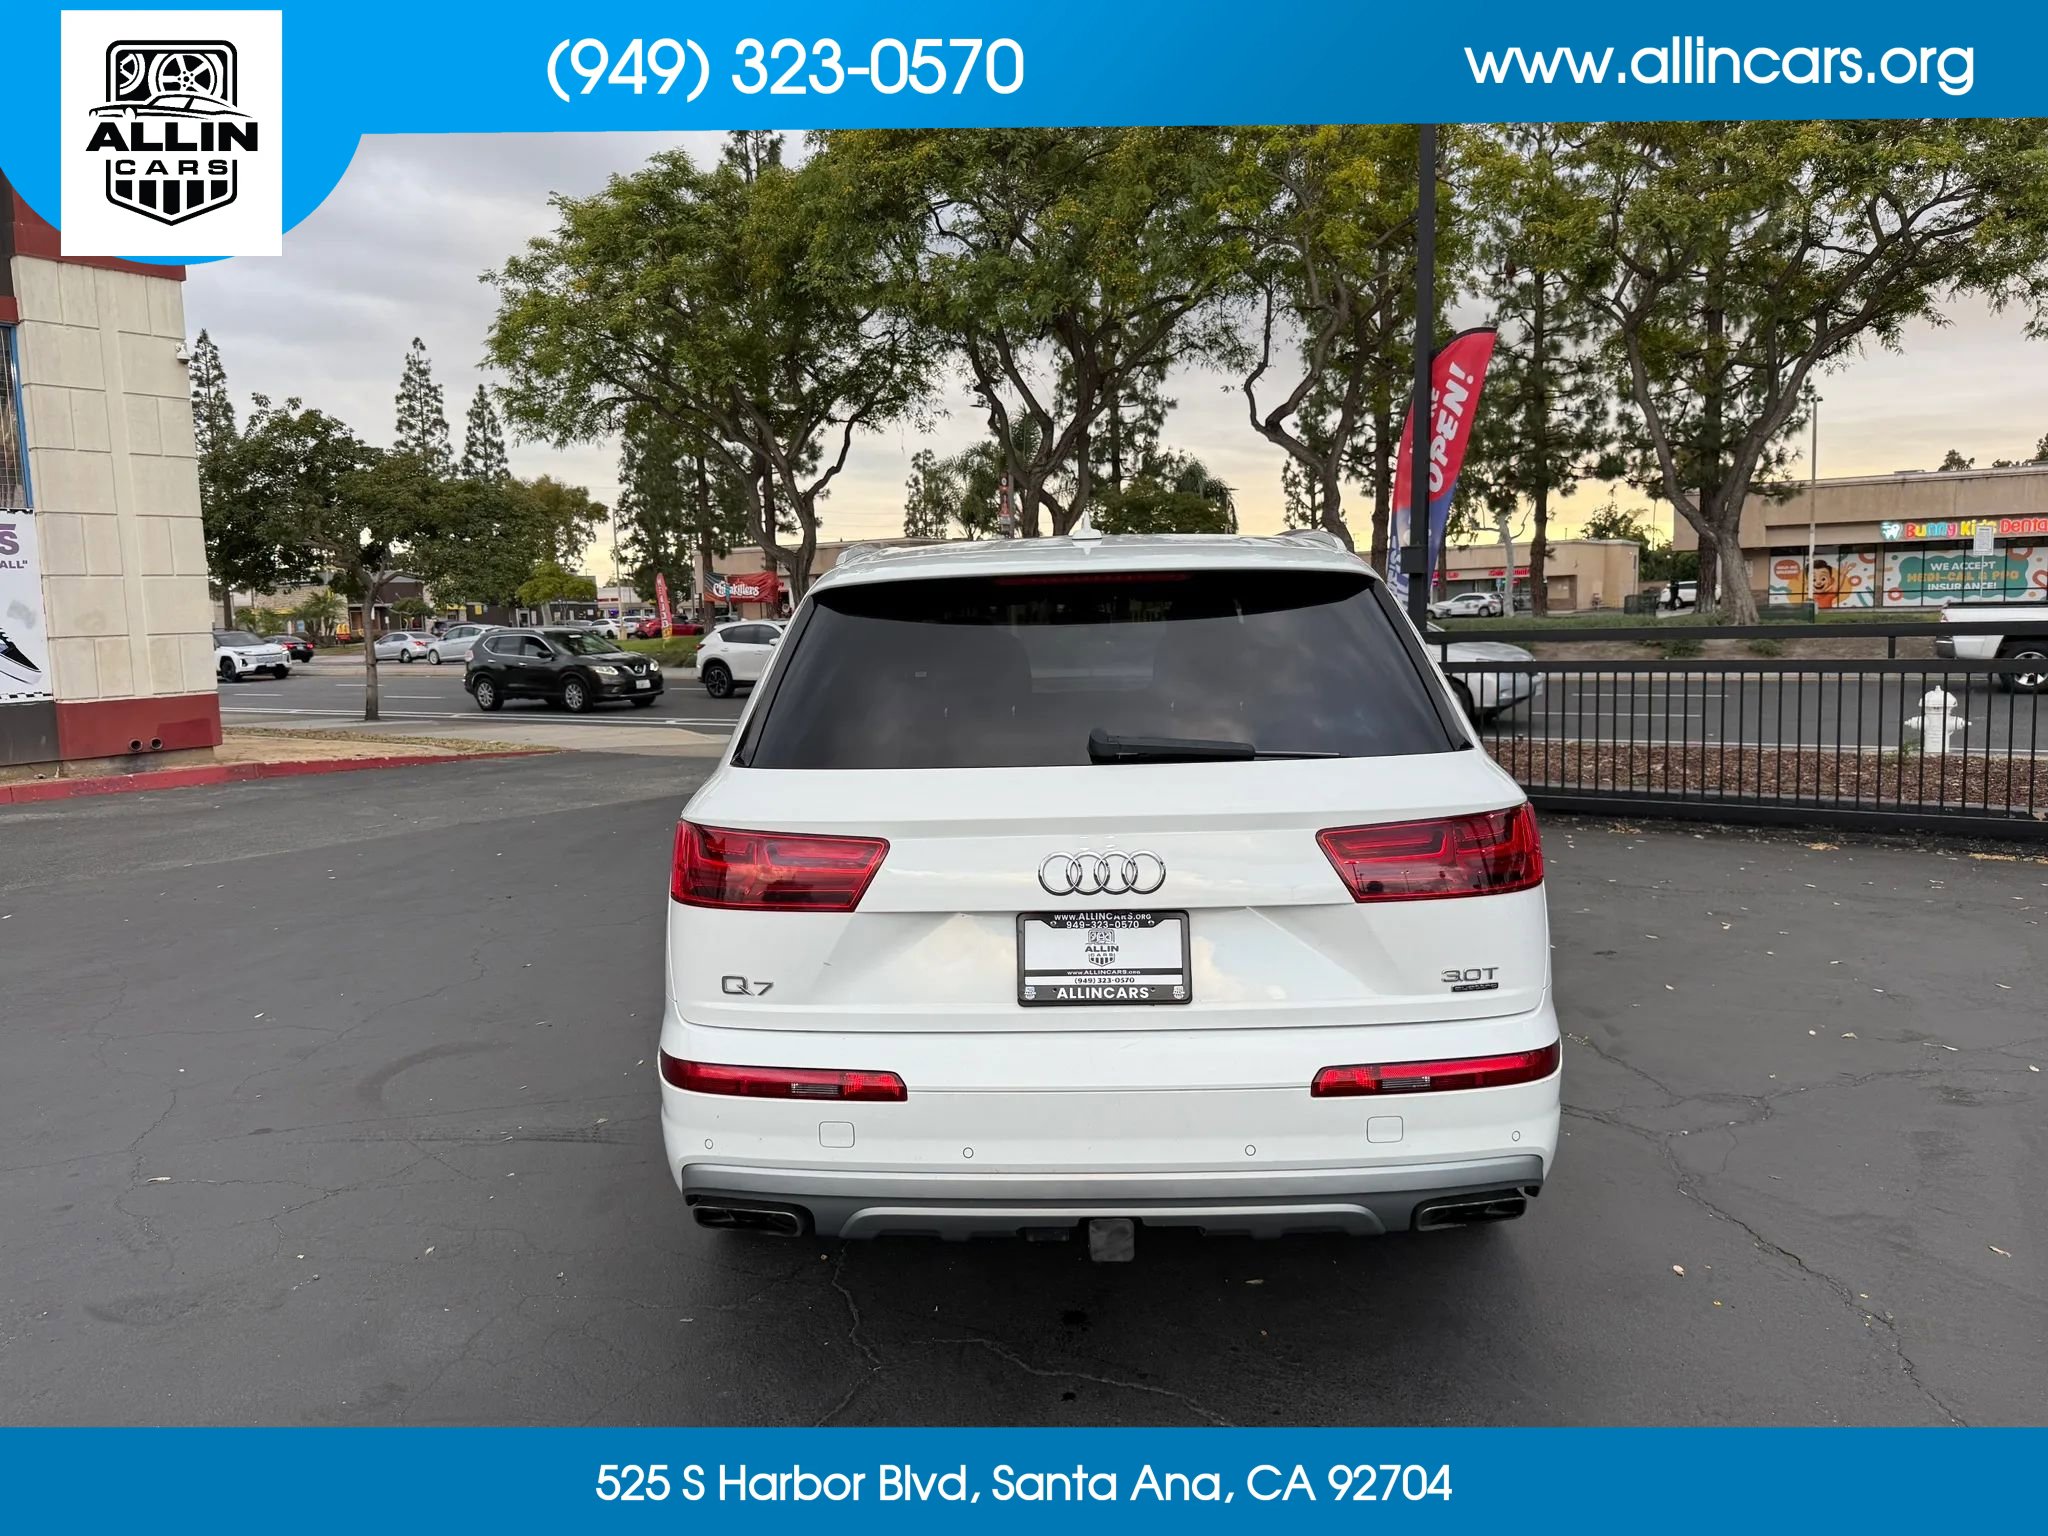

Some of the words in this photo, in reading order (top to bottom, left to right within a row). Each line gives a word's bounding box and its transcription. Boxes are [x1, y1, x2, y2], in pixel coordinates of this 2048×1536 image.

[1429, 361, 1474, 493] OPEN!
[1904, 521, 1958, 538] Bunny
[1930, 562, 1949, 571] WE
[1951, 561, 1996, 570] ACCEPT
[1927, 582, 1997, 591] INSURANCE!
[1066, 920, 1140, 929] 949-323-0570
[1085, 945, 1119, 953] ALLIN
[1075, 977, 1096, 985] (949)
[1097, 976, 1135, 984] 323-0570
[721, 975, 774, 997] Q7
[1056, 986, 1150, 999] ALLINCARS
